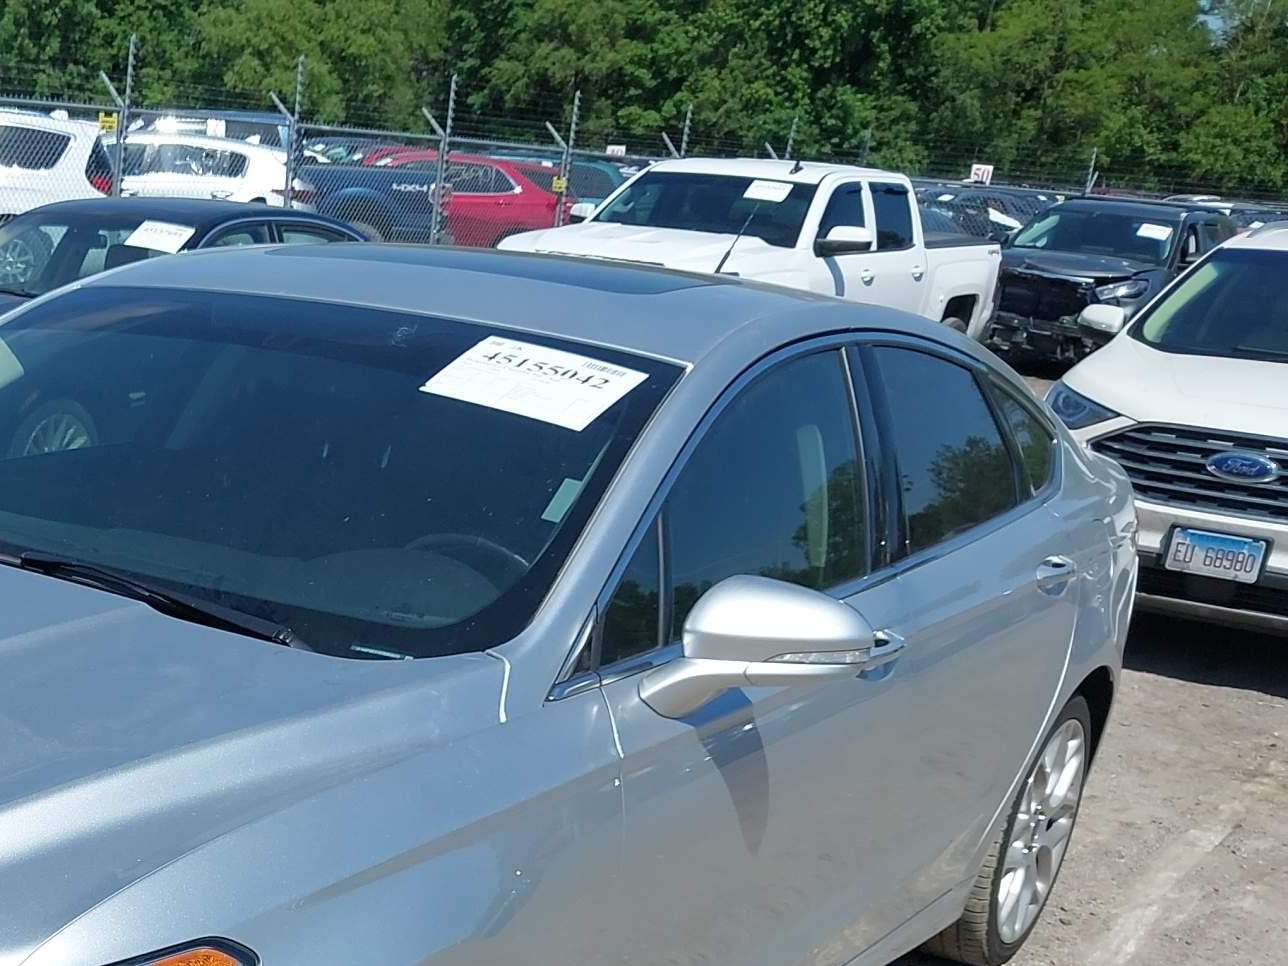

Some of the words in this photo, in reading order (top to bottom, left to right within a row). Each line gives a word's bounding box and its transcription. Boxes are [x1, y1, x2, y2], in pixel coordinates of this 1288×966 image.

[481, 351, 610, 390] 45155042
[1220, 458, 1261, 477] Ford
[1173, 541, 1196, 564] EU
[1203, 547, 1257, 574] 68980
